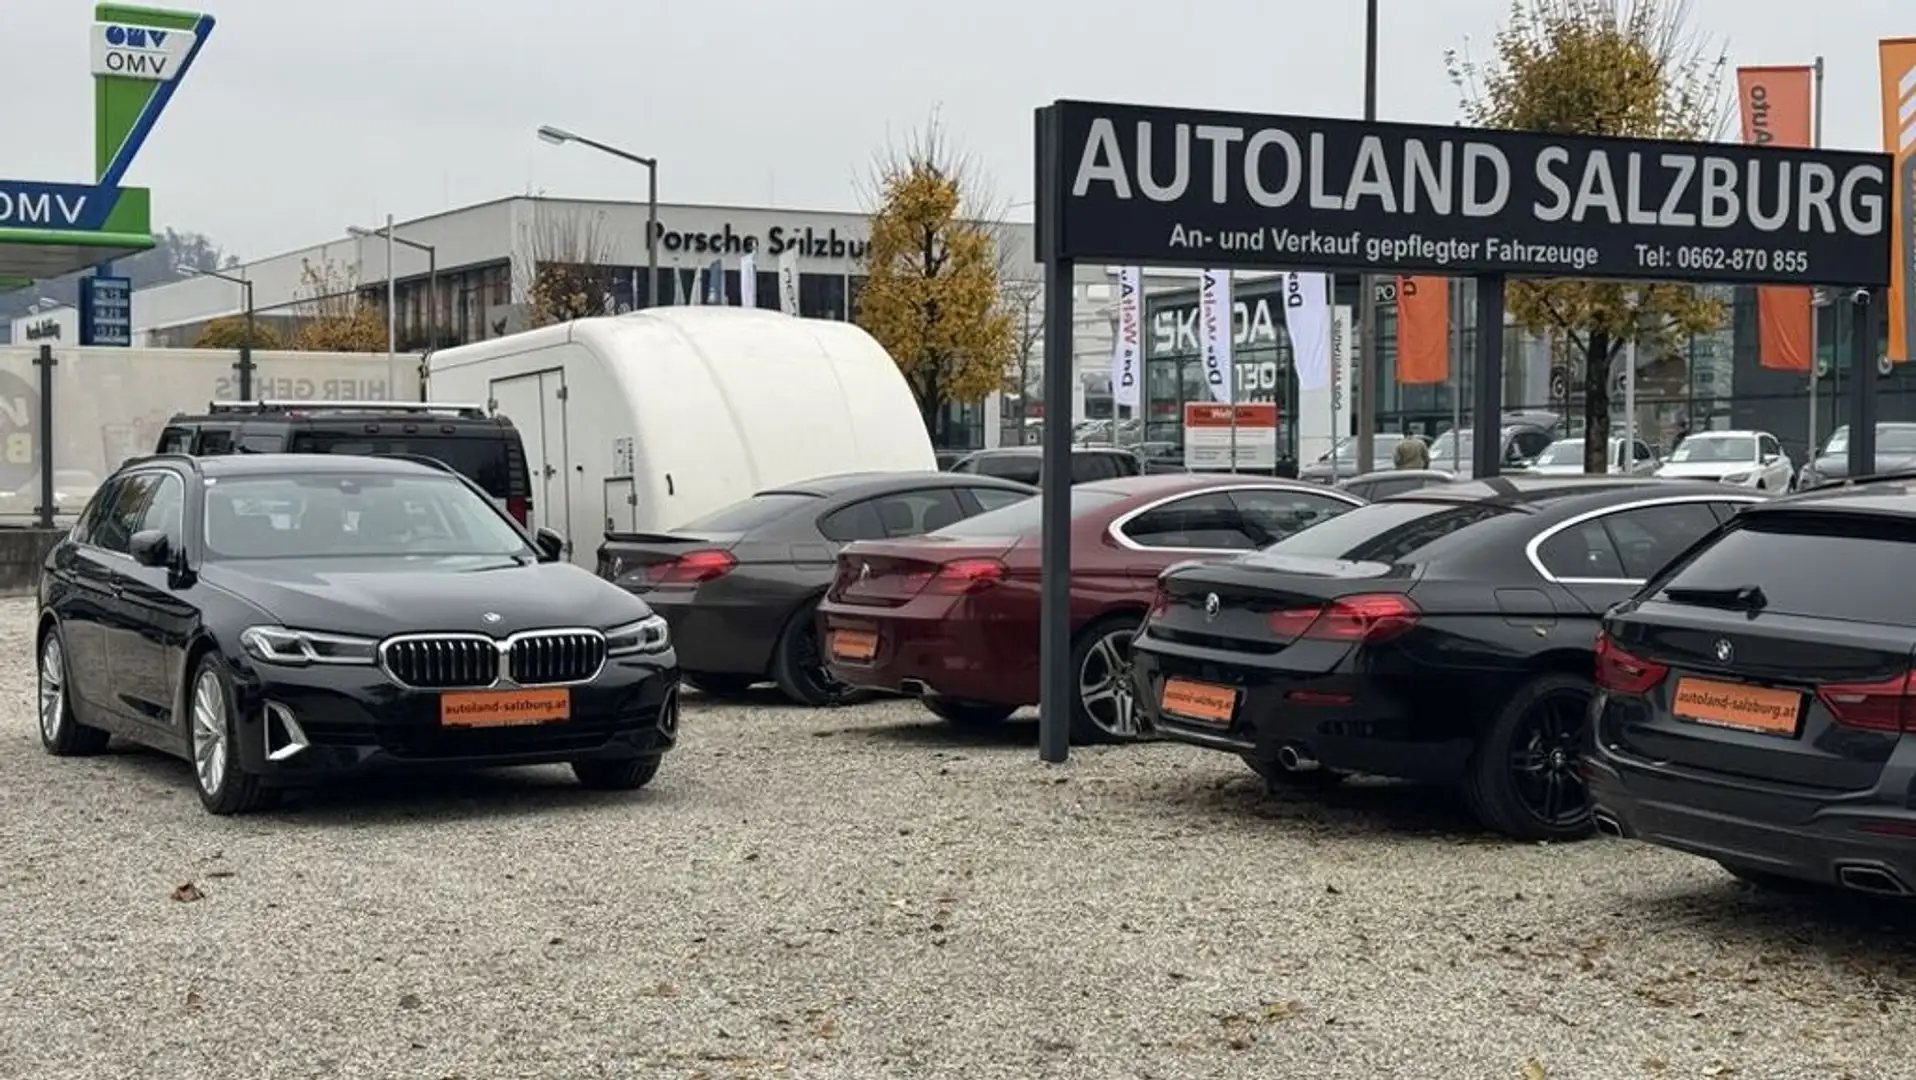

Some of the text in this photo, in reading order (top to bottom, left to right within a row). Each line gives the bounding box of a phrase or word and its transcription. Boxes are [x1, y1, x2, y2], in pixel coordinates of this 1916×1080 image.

[106, 52, 167, 74] OMV
[1072, 118, 1510, 216] AUTOLAND
[1534, 146, 1884, 236] SALZBURG
[646, 220, 759, 253] Porsche
[1169, 223, 1808, 272] An- und Verkauf gepflegter Fahrzeuge Tel: 0662-870 855
[1679, 692, 1796, 719] autoland-salzburg.at
